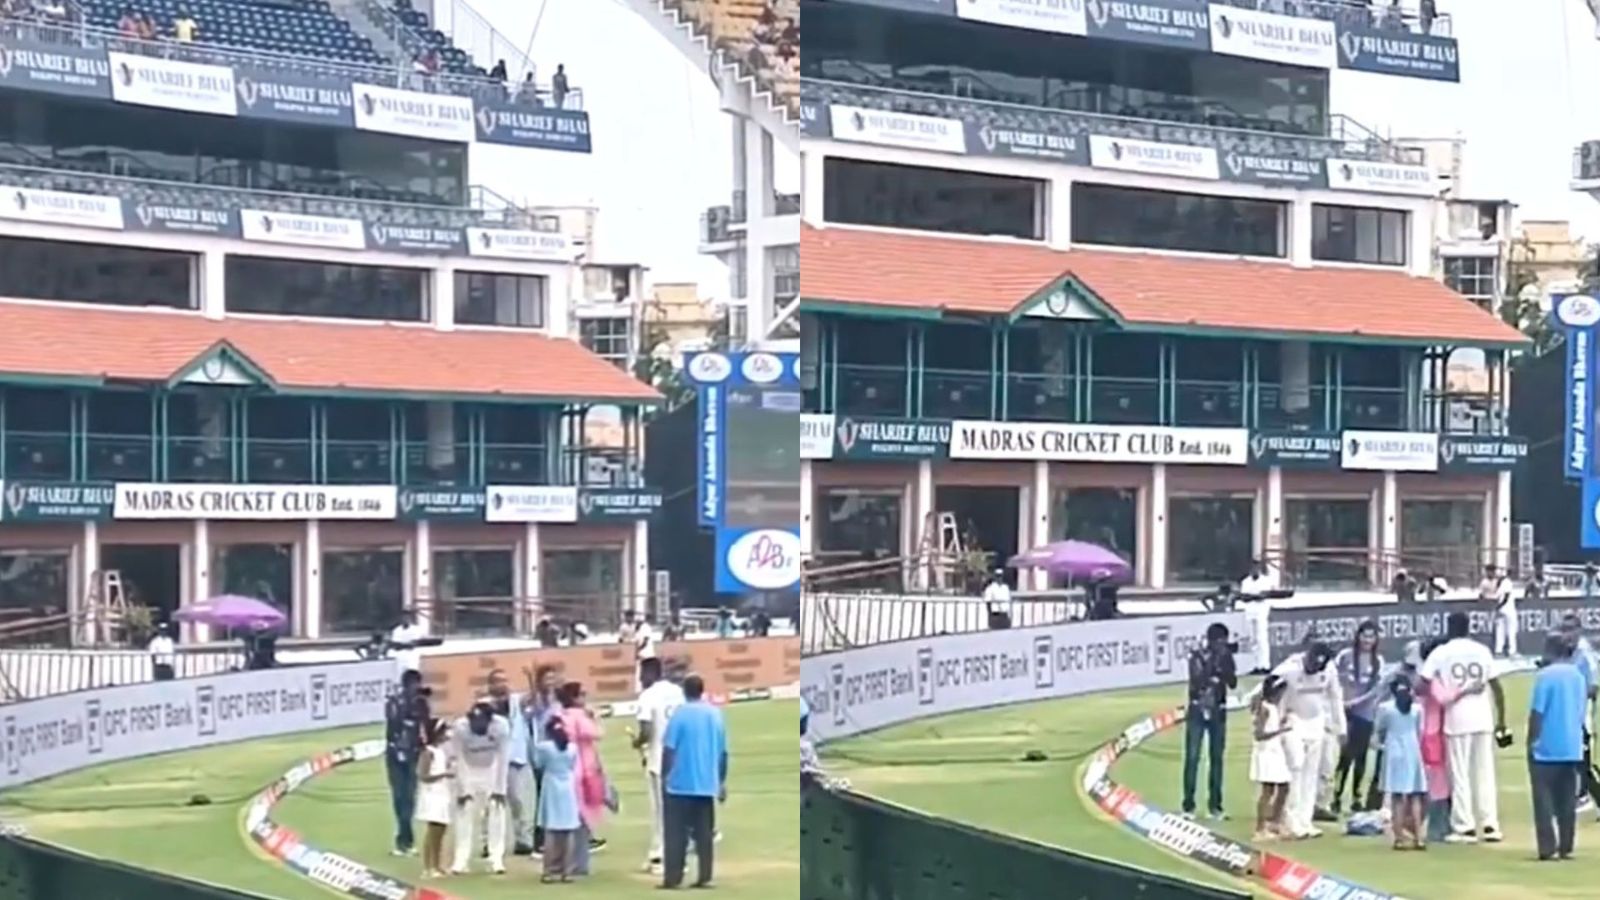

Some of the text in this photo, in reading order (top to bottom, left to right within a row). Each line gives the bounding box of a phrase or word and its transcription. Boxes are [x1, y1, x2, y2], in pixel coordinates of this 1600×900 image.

[1111, 2, 1207, 29] SHARIEF BHAI
[1237, 21, 1332, 46] SHARIEF BHAI
[1362, 36, 1456, 63] SHARIEF BHAI
[15, 50, 108, 76] SHARIEF BHAI
[138, 67, 231, 93] SHARIEF BHAI
[260, 82, 352, 107] SHARIEF BHAI
[499, 111, 587, 134] SHARIEF BHAI
[859, 422, 950, 443] SHARIEF BHAI
[961, 429, 1035, 451] MADRAS
[1042, 430, 1121, 454] CRICKET
[1128, 433, 1174, 455] CLUB
[26, 487, 114, 505] SHARIEF BHAI
[124, 490, 195, 511] MADRAS
[200, 490, 275, 512] CRICKET
[282, 492, 327, 512] CLUB
[1378, 612, 1441, 638] STERLING
[1057, 640, 1149, 671] IDFC FIRST Bank
[936, 652, 1030, 688] IDFC FIRST Bank
[1451, 662, 1483, 689] 99
[330, 682, 352, 707] IDFC
[354, 679, 382, 704] FIRST
[865, 669, 888, 700] FIRST
[891, 667, 914, 697] Bank
[218, 689, 306, 721] IDFC FIRST Bank
[103, 700, 193, 737] IDFC FIRST Bank
[36, 720, 59, 749] FIRST
[61, 718, 83, 746] Bank
